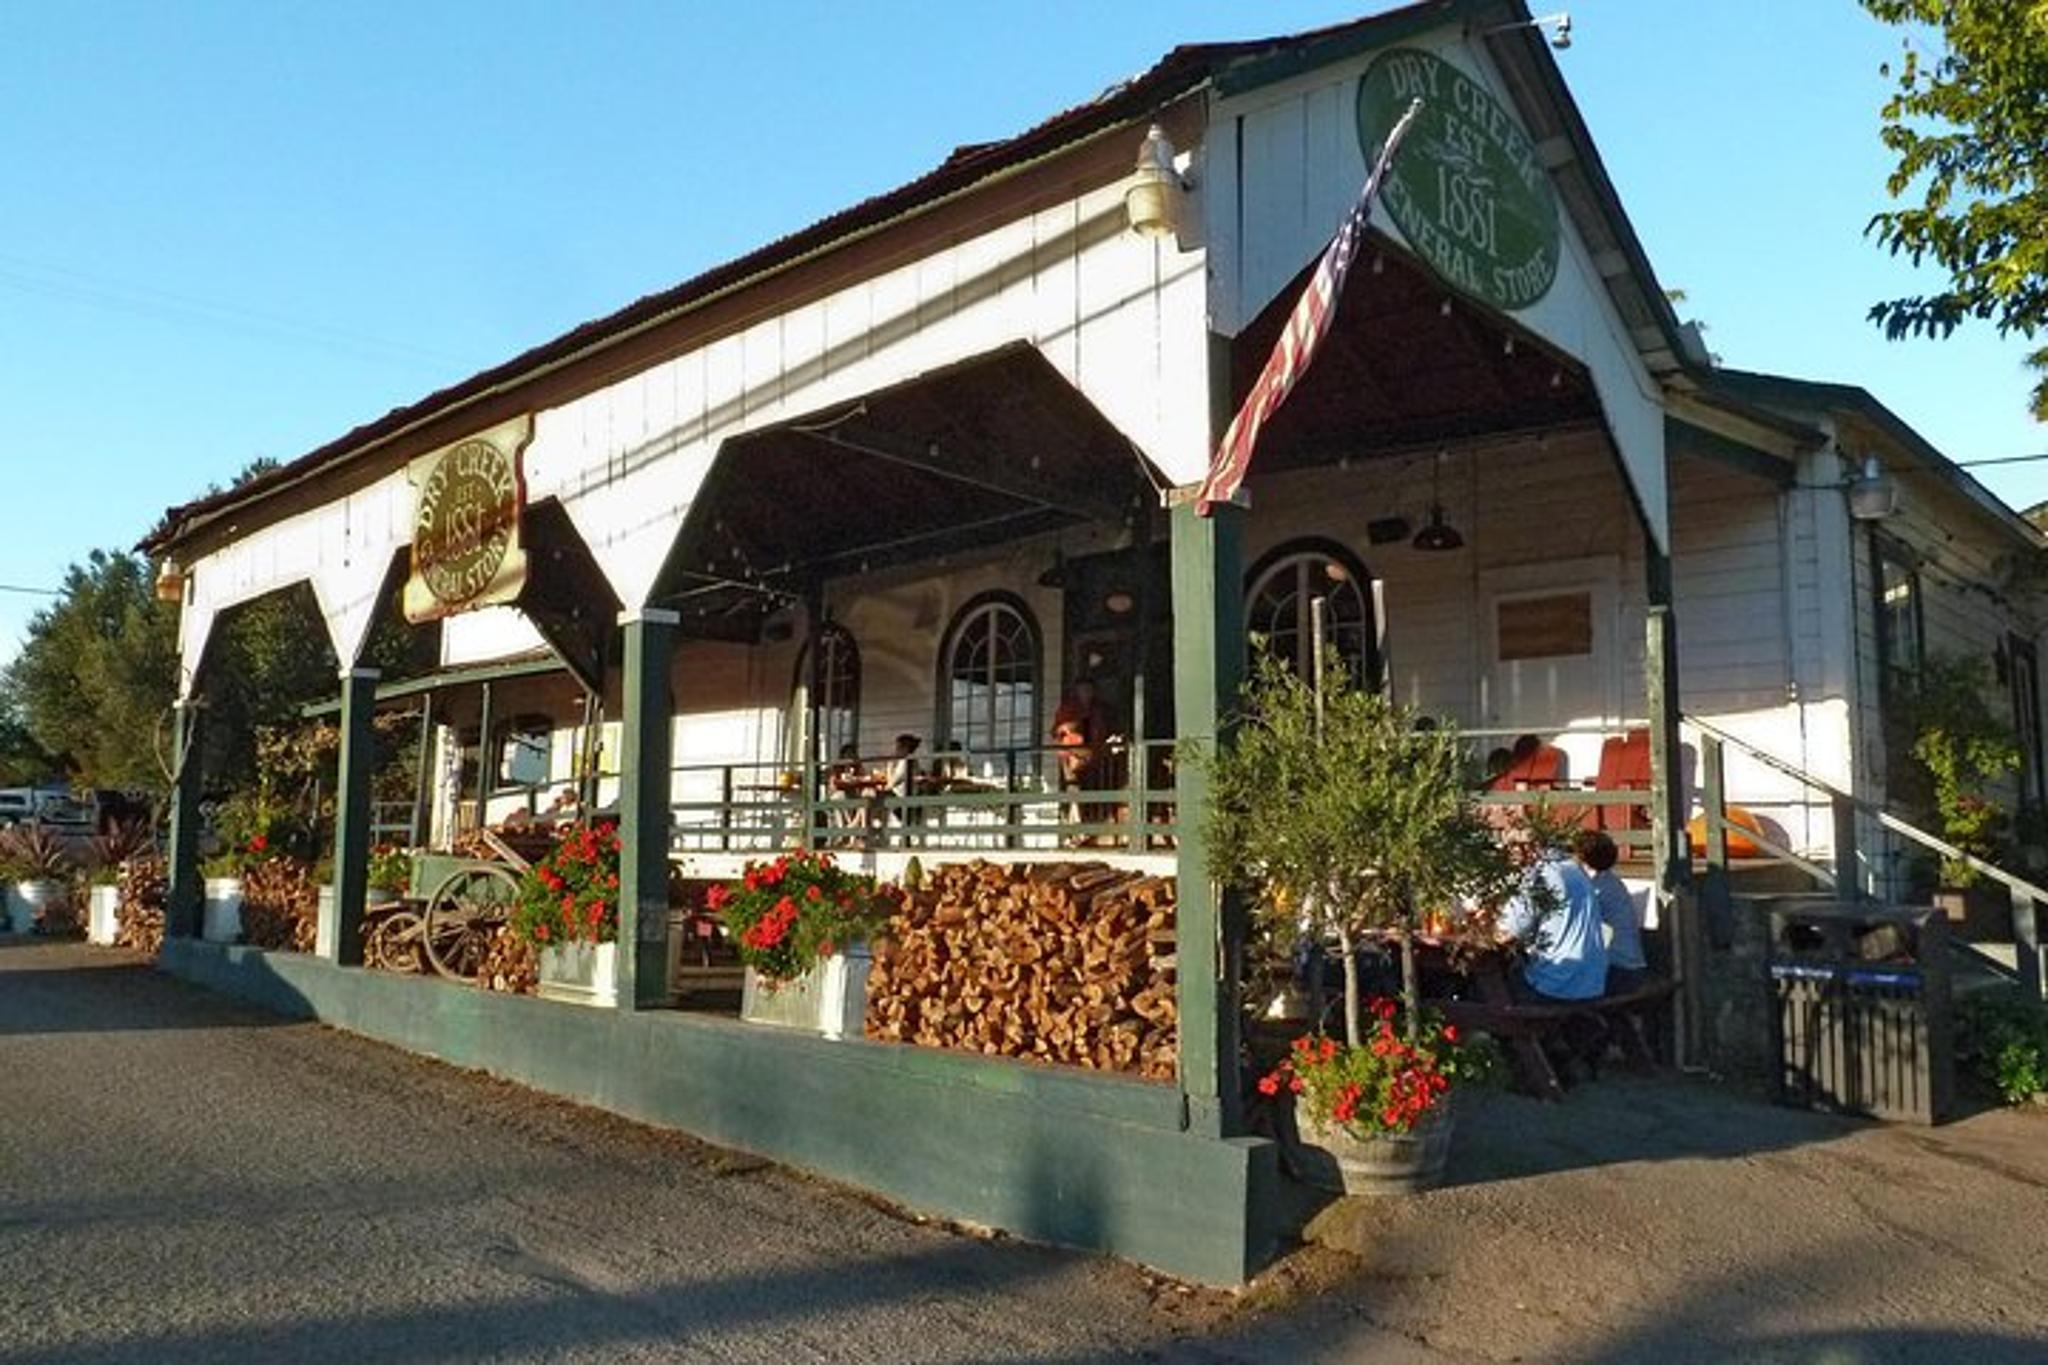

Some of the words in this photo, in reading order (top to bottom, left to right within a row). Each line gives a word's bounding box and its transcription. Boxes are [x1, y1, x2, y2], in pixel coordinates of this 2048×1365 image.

[1388, 54, 1440, 98] DRY
[1452, 76, 1541, 192] CREEK
[1437, 163, 1498, 257] 1881
[1492, 247, 1552, 303] STORE
[418, 459, 448, 529] DRY
